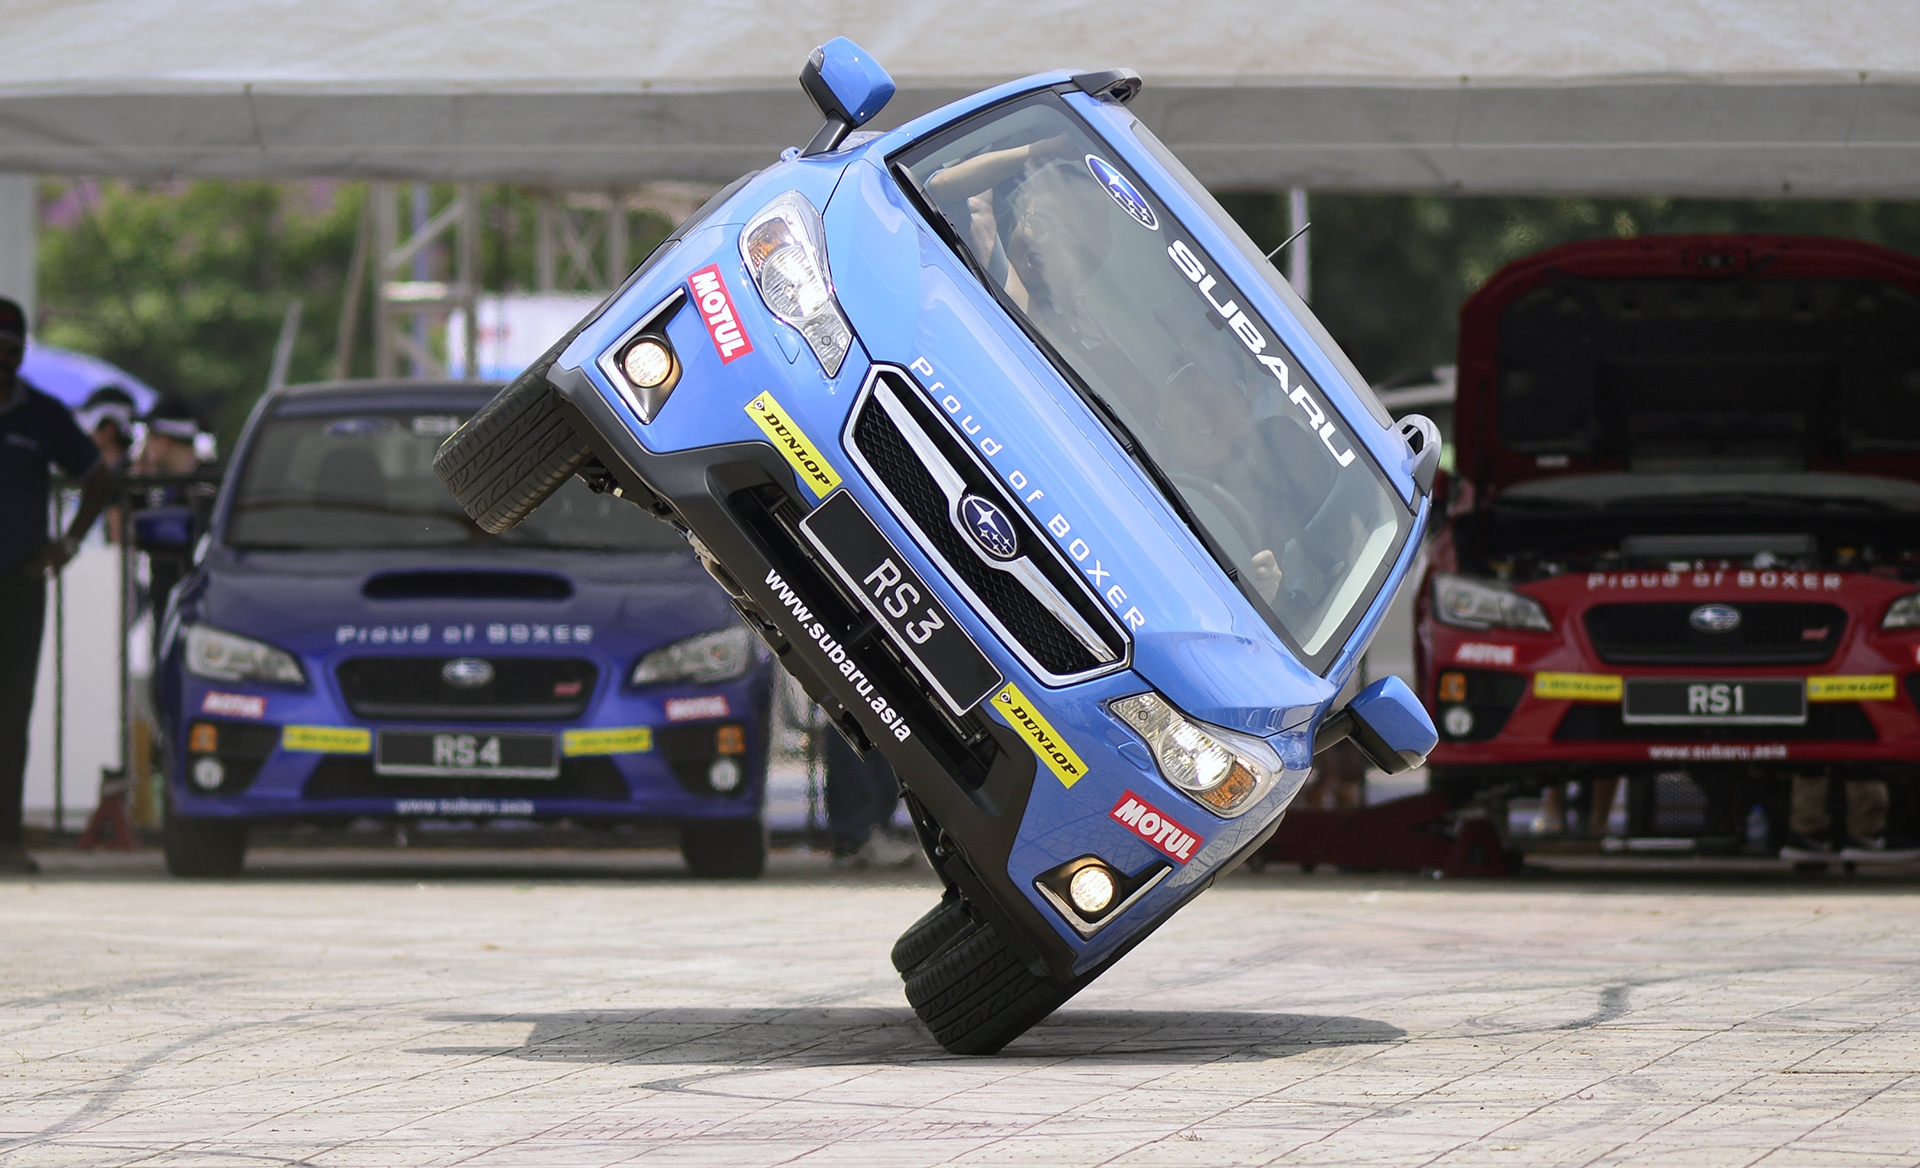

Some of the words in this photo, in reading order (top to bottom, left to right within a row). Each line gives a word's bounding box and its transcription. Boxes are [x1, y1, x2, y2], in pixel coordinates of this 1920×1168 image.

[692, 271, 745, 358] MOTUL
[1167, 239, 1356, 468] SUBARU
[763, 412, 831, 486] DUNLOP
[910, 356, 1003, 457] Proud
[1008, 470, 1044, 503] of
[1047, 513, 1146, 632] BOXER
[1587, 572, 1680, 590] Proud
[1693, 572, 1724, 588] of
[1737, 572, 1842, 590] BOXER
[764, 568, 912, 742] www.subaru.asia
[1010, 706, 1077, 776] DUNLOP
[1113, 798, 1196, 859] MOTUL
